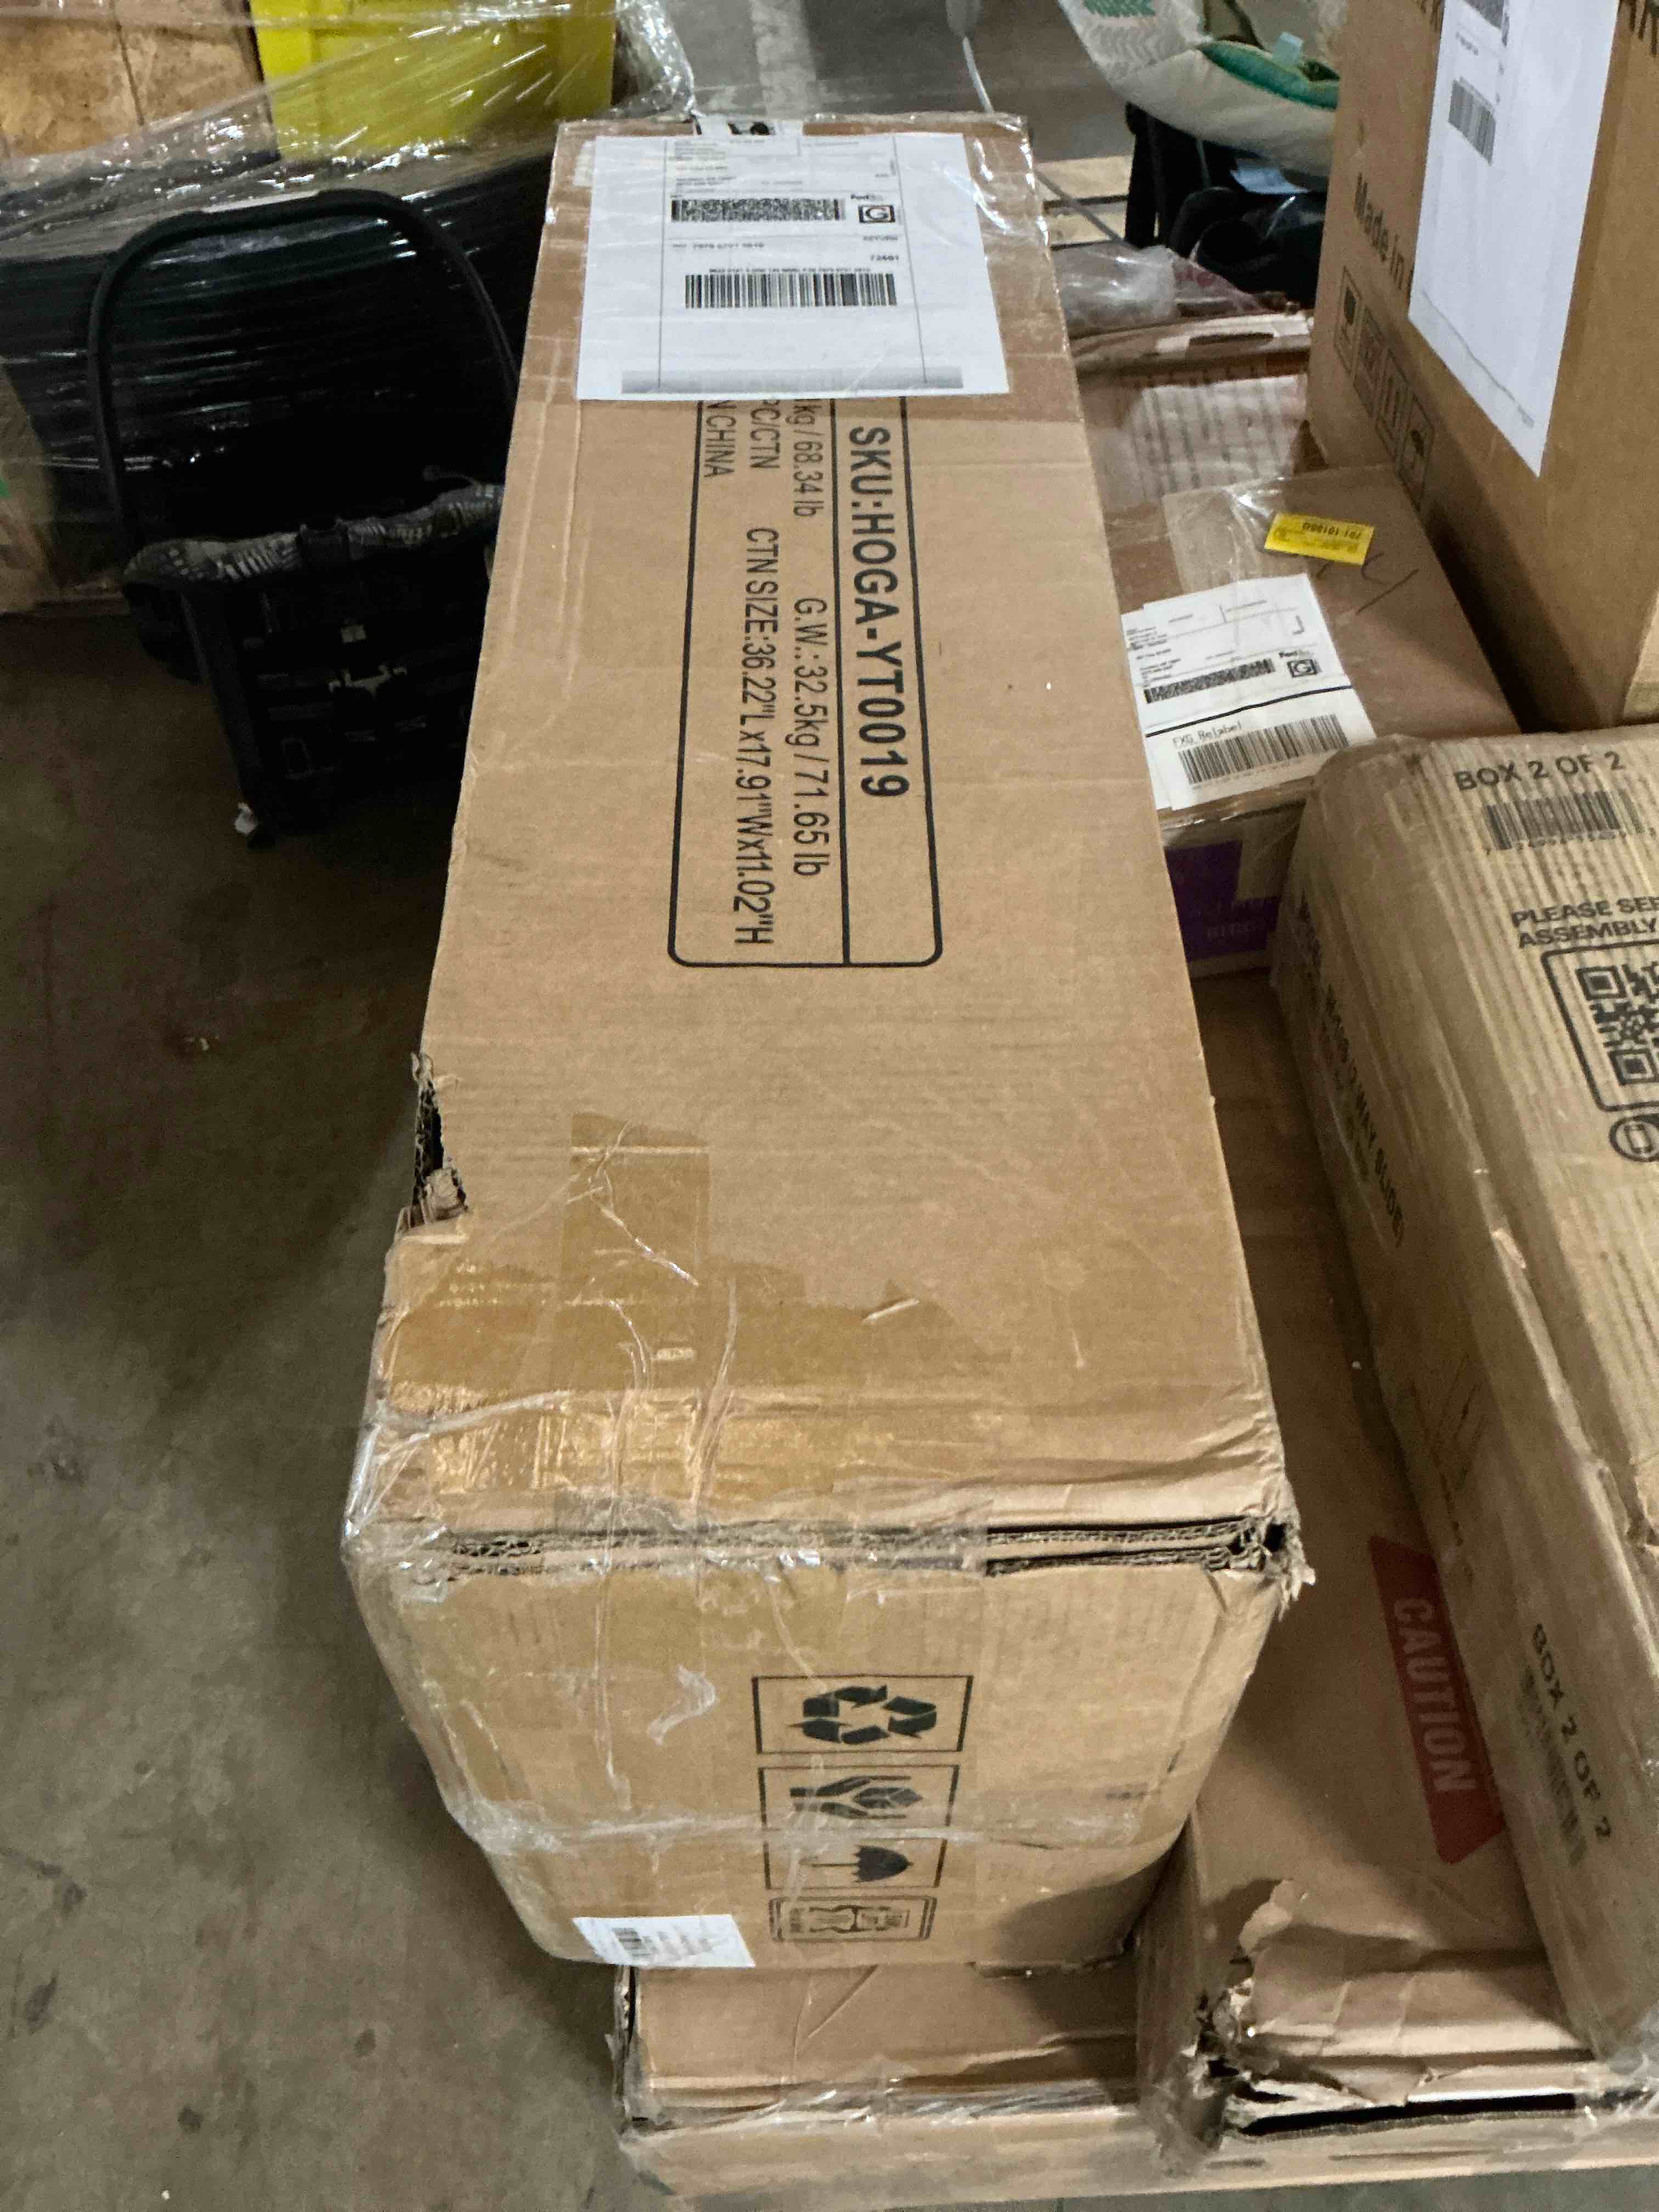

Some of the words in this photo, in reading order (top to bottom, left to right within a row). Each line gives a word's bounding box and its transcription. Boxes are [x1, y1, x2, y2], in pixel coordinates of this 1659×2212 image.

[785, 398, 822, 425] kg
[703, 415, 737, 478] CHINA
[746, 527, 780, 574] CTN
[849, 426, 910, 797] SKU:HOGA-YT0019
[1454, 760, 1522, 791] BOX
[1527, 760, 1550, 780] 2
[1555, 754, 1594, 776] OF
[1604, 751, 1626, 771] 2
[1511, 900, 1613, 928] PLEASE
[1519, 917, 1656, 949] ASSEMBLY
[1531, 1623, 1564, 1709] BOX
[1393, 1595, 1476, 1792] CAUTION
